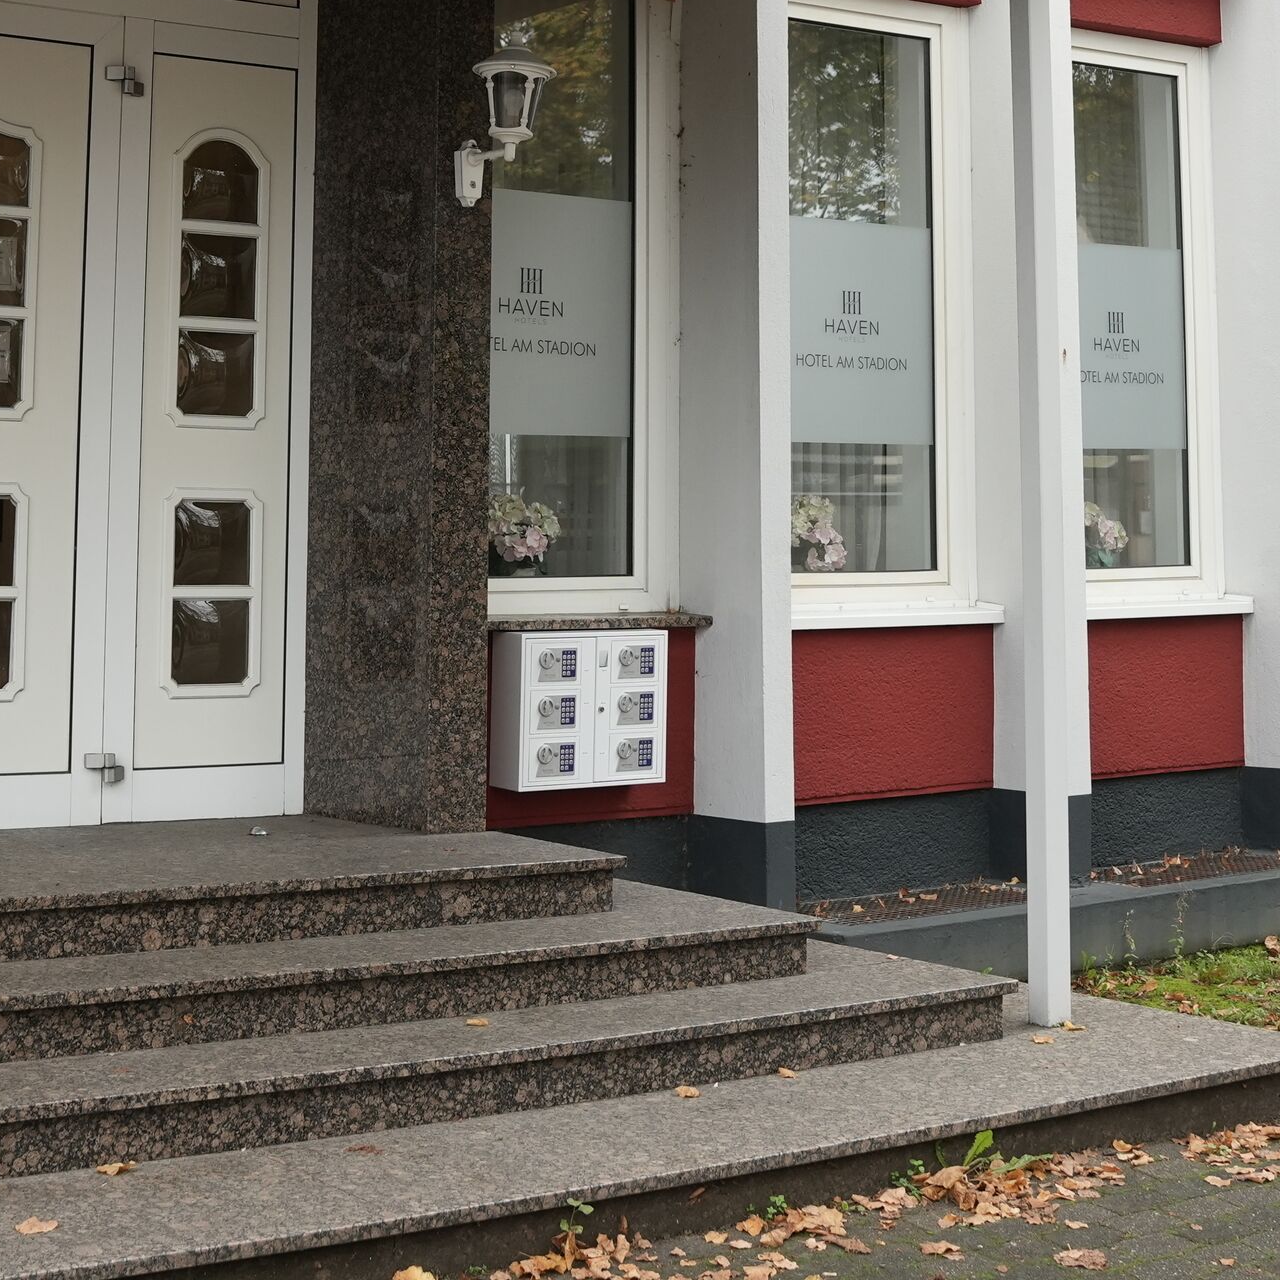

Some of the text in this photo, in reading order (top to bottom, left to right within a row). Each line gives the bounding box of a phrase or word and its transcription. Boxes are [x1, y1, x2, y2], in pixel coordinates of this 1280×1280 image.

[498, 297, 565, 318] HAVEN
[824, 318, 880, 336] HAVEN
[511, 338, 533, 353] AM
[537, 339, 597, 357] STADION
[1093, 337, 1140, 353] HAVEN
[796, 353, 908, 371] HOTEL AM STADION
[1081, 370, 1164, 385] OTEL AM STADION
